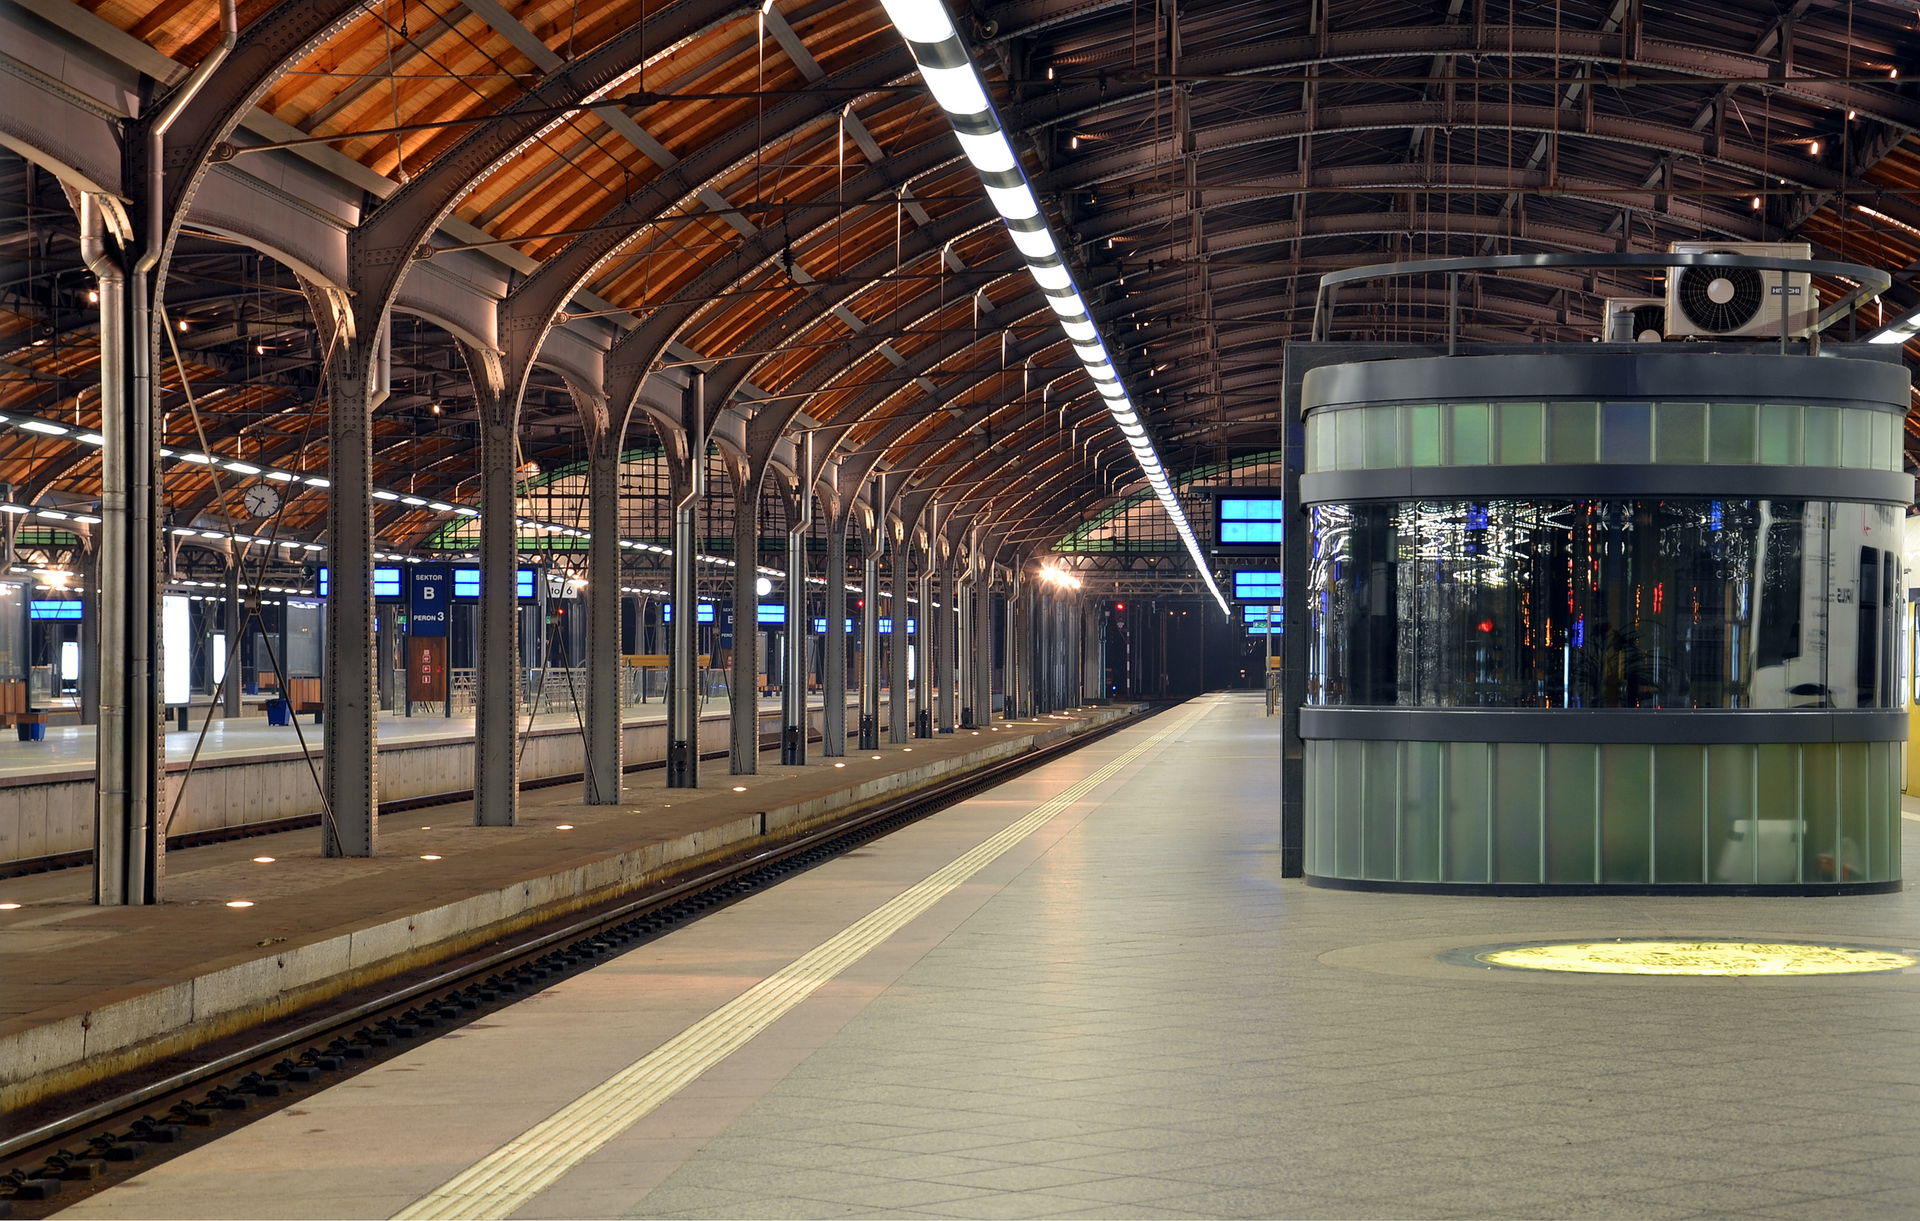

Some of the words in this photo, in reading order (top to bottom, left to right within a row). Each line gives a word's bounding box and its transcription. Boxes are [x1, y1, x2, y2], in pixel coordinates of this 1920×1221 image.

[423, 586, 435, 600] B
[566, 586, 573, 595] 6
[437, 611, 445, 621] 3
